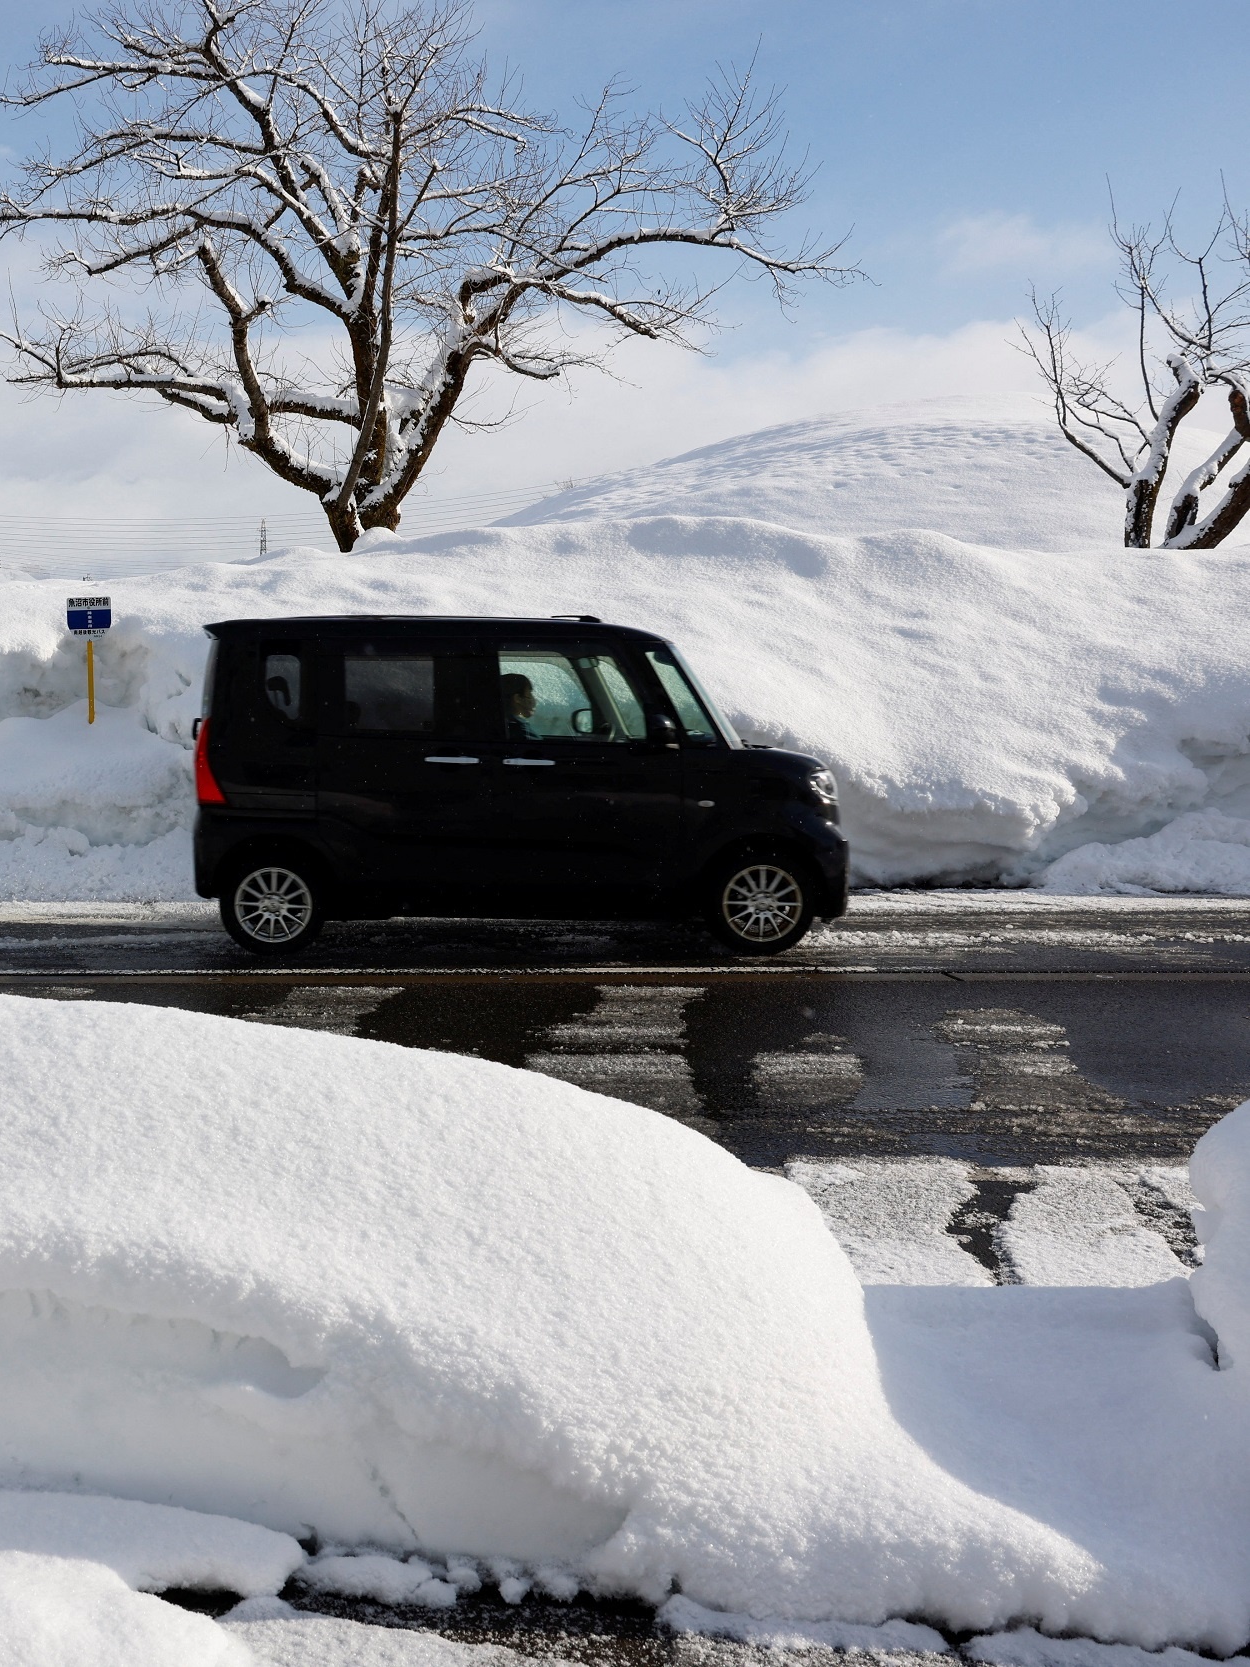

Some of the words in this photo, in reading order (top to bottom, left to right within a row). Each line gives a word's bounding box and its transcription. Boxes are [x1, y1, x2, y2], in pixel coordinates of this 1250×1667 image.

[69, 597, 109, 607] 魚沼市役所前
